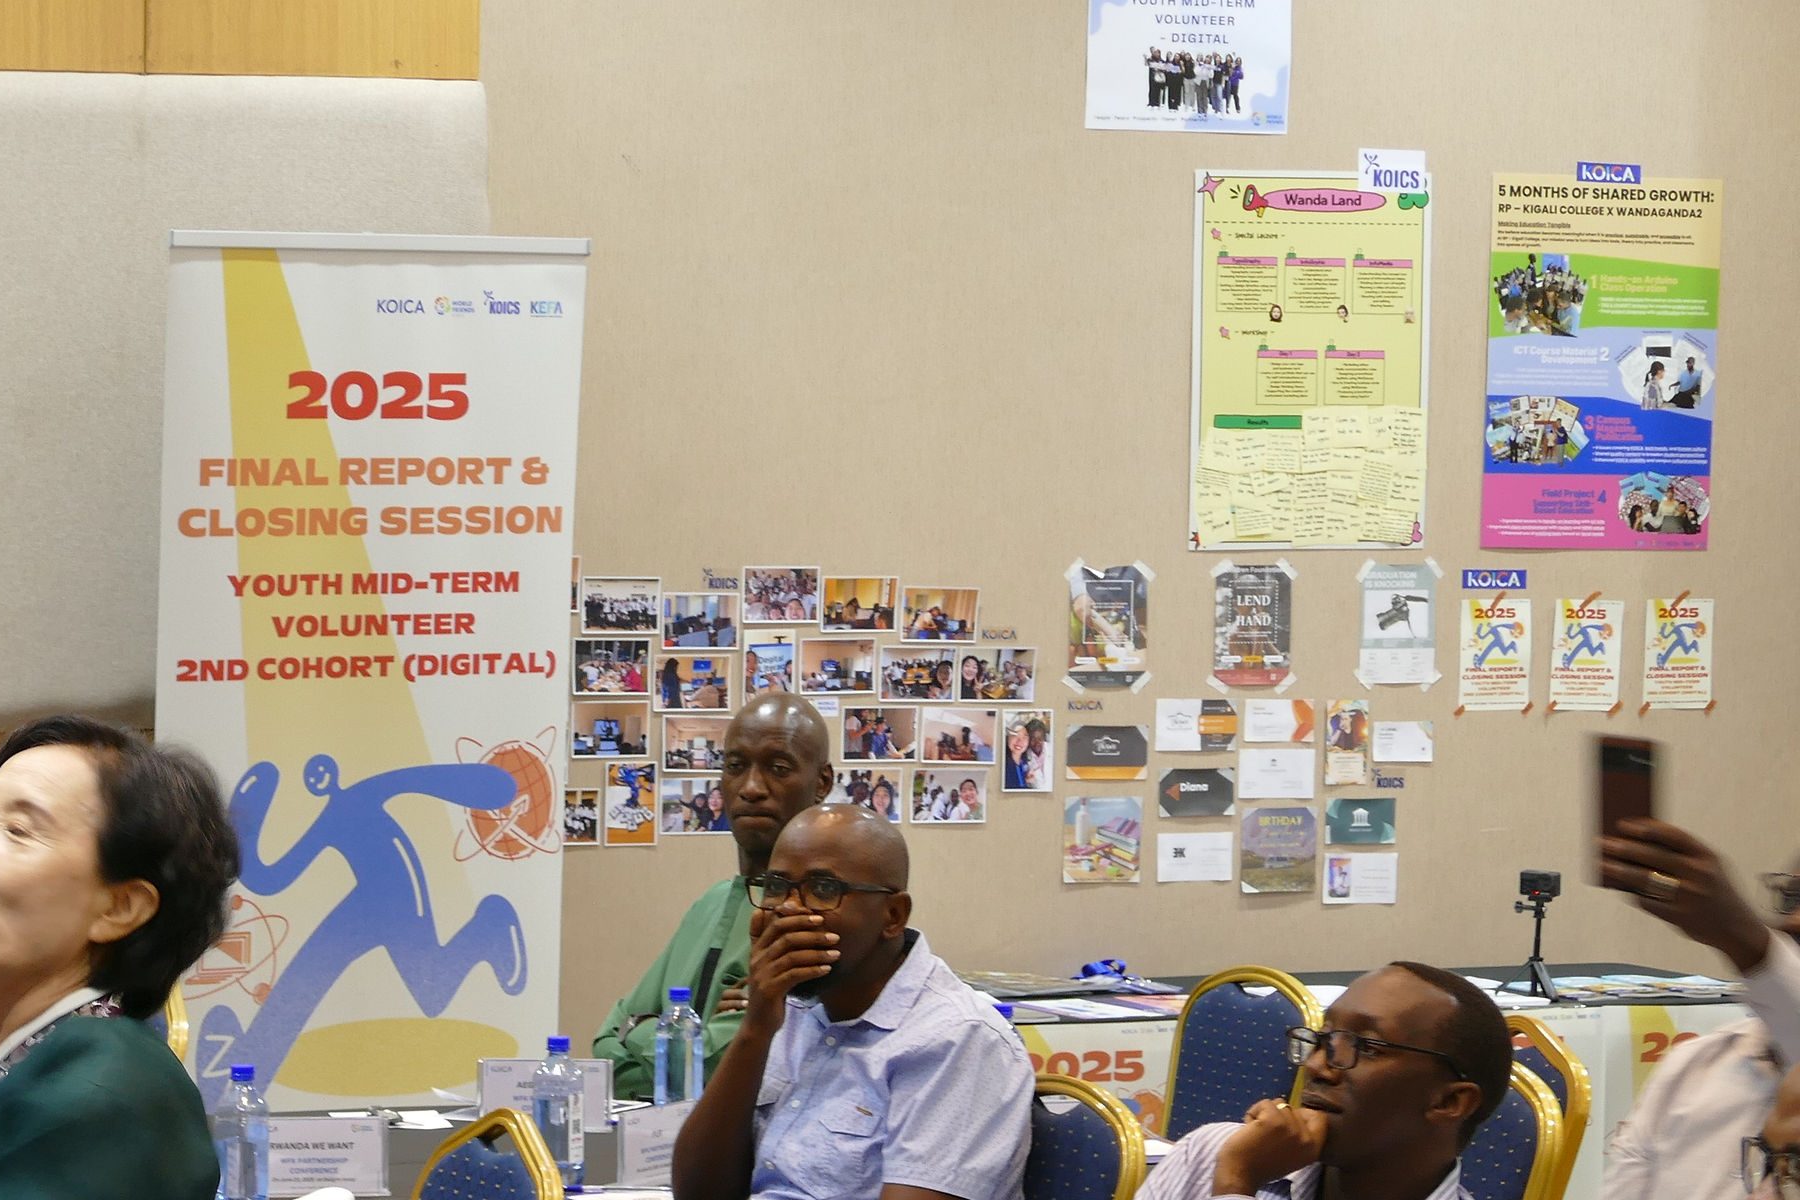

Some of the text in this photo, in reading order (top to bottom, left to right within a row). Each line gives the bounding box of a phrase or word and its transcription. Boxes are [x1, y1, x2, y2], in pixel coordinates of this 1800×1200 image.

[1182, 0, 1255, 8] MID-TERM
[1155, 14, 1236, 26] VOLUNTEER
[1171, 33, 1229, 44] DIGITAL
[1373, 169, 1420, 189] KOICS
[1582, 164, 1635, 182] KOICA
[1285, 194, 1362, 206] Wanda Land
[1498, 185, 1715, 203] 5 MONTHS OF SHARED GROWTH:
[1498, 204, 1703, 219] RP KIGALI COLLEGE X WANDAGANDA2
[377, 299, 425, 314] KOICA
[489, 301, 520, 315] KOICS
[530, 301, 563, 314] KEFA
[1600, 347, 1610, 361] 2
[286, 370, 470, 421] 2025
[1584, 415, 1594, 430] 3
[199, 456, 549, 487] FINAL REPORT &
[177, 505, 563, 538] CLOSING SESSION
[227, 571, 519, 598] YOUTH MID-TERM
[708, 577, 738, 590] KOICS
[1467, 571, 1521, 587] KOICA
[1237, 595, 1271, 606] LEND
[1474, 608, 1516, 619] 2025
[1566, 608, 1606, 619] 2025
[1659, 607, 1699, 619] 2025
[272, 612, 476, 639] VOLUNTEER
[1236, 615, 1272, 626] HAND
[981, 628, 1017, 640] KOICA
[175, 650, 556, 683] 2ND COHORT (DIGITAL)
[1068, 700, 1104, 711] KOICA
[1179, 782, 1209, 793] Diana
[1376, 776, 1405, 789] KOICS
[312, 1142, 326, 1150] WE
[327, 1141, 355, 1150] WANT
